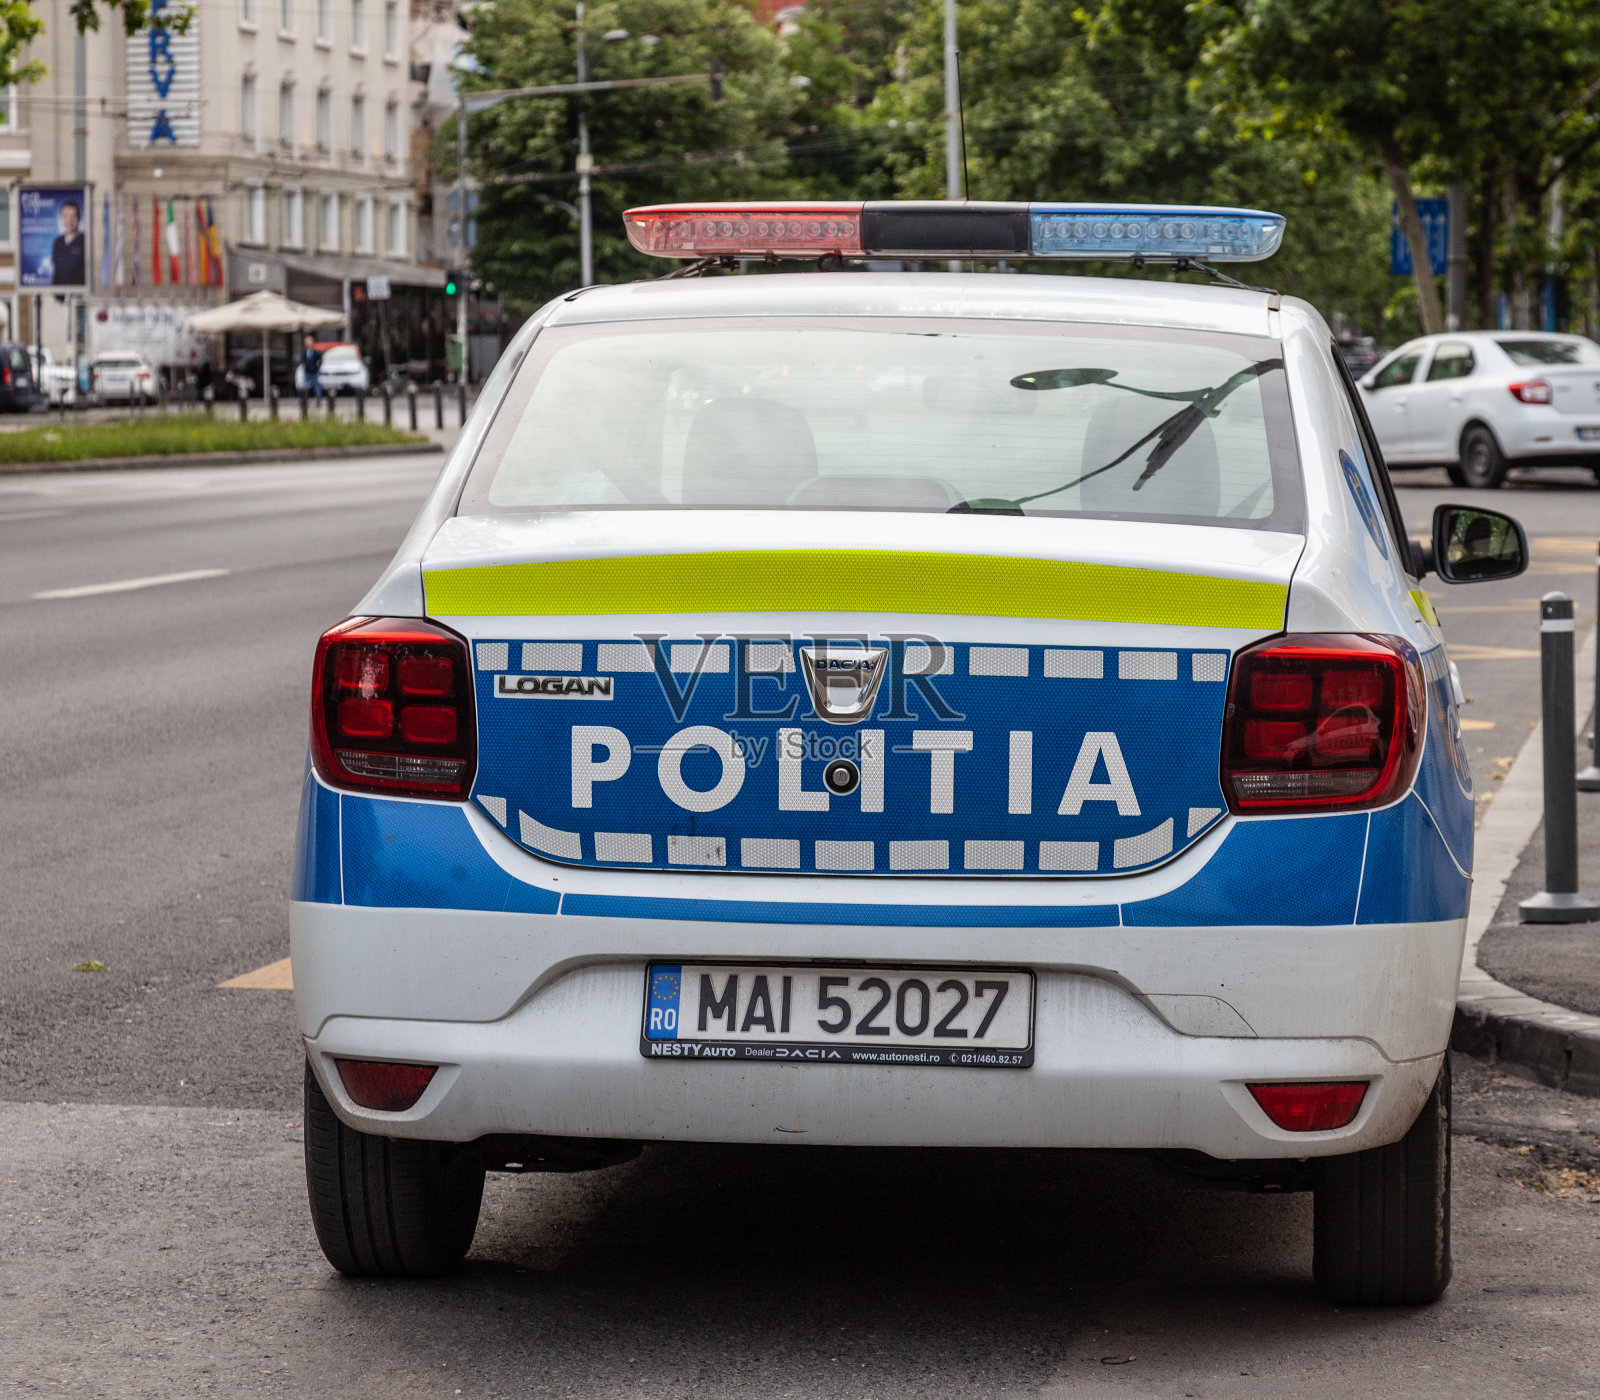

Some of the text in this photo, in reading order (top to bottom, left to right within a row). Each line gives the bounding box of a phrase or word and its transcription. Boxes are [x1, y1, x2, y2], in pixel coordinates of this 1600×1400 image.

[815, 659, 872, 671] DACIA
[498, 675, 611, 695] LOGAN
[571, 725, 1141, 816] POLITIA
[698, 974, 1009, 1038] MAI 52027
[650, 1008, 676, 1031] RO
[651, 1043, 1023, 1065] NESTY AUTO Dealer DACIA www.autonesti.ro 021/460.82.57
